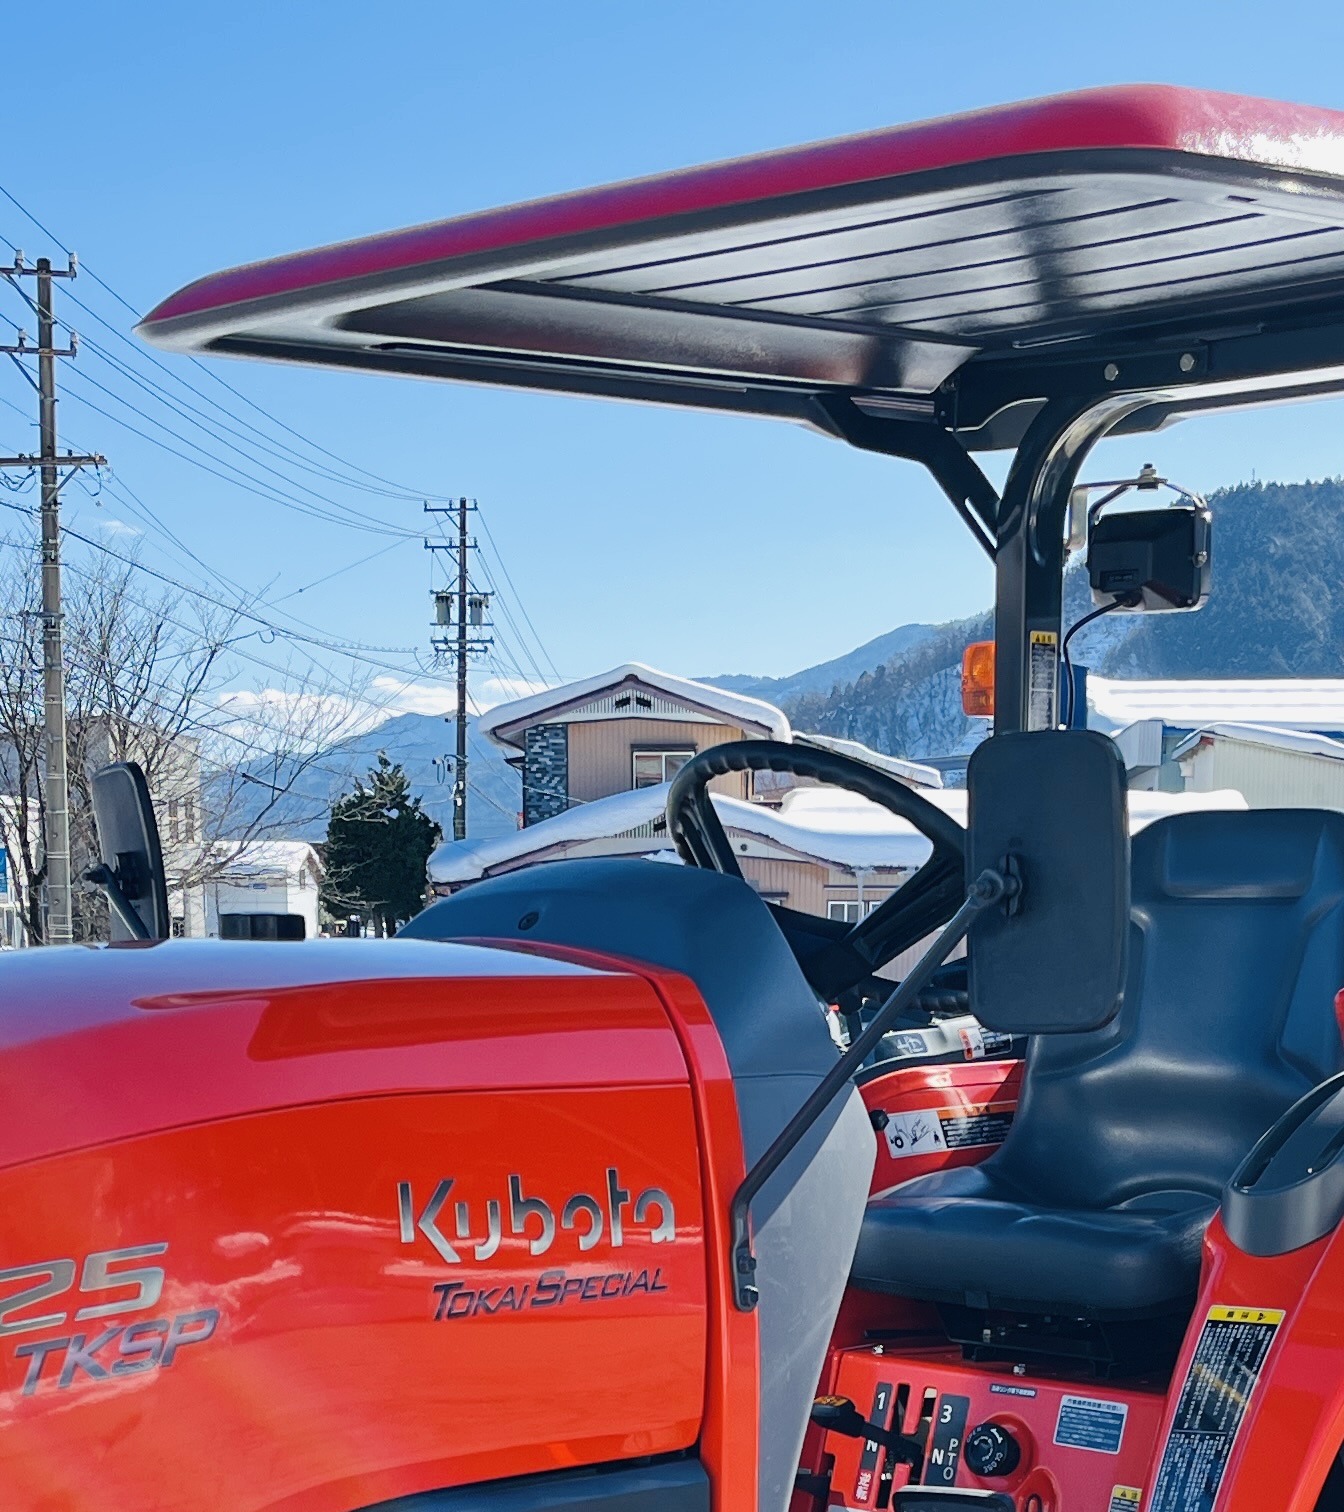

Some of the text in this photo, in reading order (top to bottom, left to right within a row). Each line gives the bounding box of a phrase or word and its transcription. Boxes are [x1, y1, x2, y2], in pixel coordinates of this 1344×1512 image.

[397, 1168, 676, 1263] Kubota
[15, 1307, 219, 1396] TKSP
[877, 1391, 886, 1410] 1
[940, 1405, 953, 1424] 3
[866, 1439, 877, 1453] N
[931, 1449, 944, 1466] N
[983, 1452, 1004, 1474] CLOSE
